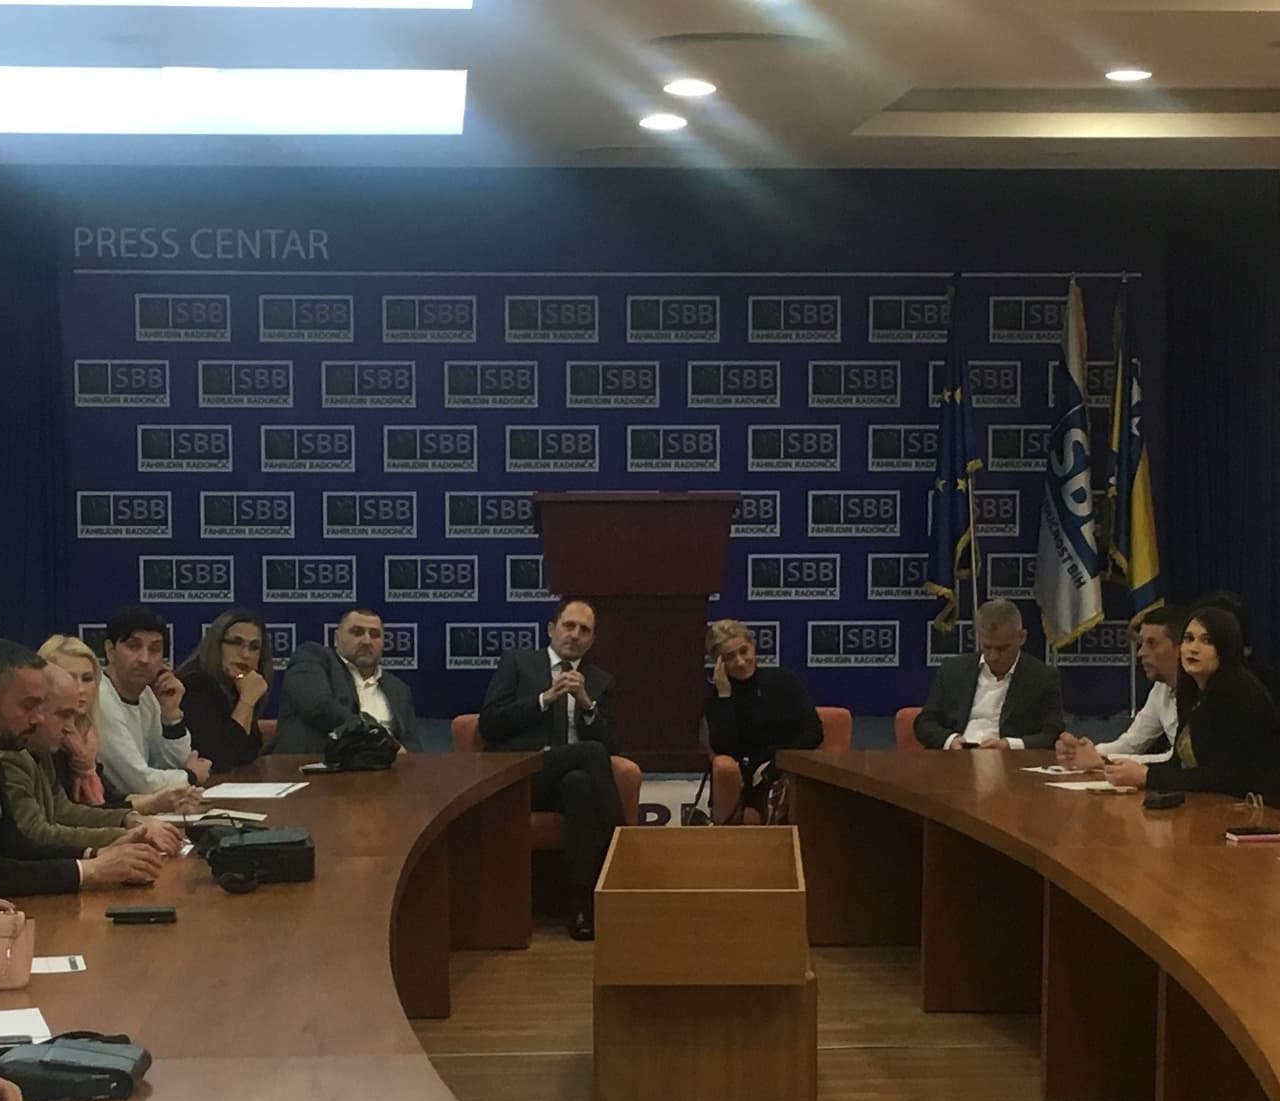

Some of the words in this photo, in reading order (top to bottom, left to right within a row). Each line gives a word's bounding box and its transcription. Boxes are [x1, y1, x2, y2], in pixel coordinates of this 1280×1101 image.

[73, 227, 179, 258] PRESS
[190, 228, 329, 259] CENTAR
[176, 303, 224, 323] SBB
[299, 304, 346, 324] SBB
[422, 304, 469, 325] SBB
[545, 304, 592, 325] SBB
[666, 305, 713, 325] SBB
[787, 305, 834, 325] SBB
[115, 369, 163, 389] SBB
[239, 369, 286, 389] SBB
[362, 370, 409, 390] SBB
[484, 370, 531, 390] SBB
[606, 370, 652, 390] SBB
[727, 370, 774, 390] SBB
[848, 370, 894, 390] SBB
[968, 370, 1014, 390] SBB
[1089, 370, 1115, 390] SB
[178, 434, 225, 454] SBB
[301, 434, 348, 454] SBB
[424, 434, 470, 454] SBB
[545, 434, 592, 454] SBB
[667, 434, 713, 454] SBB
[787, 434, 834, 454] SBB
[907, 434, 938, 454] SB
[117, 500, 165, 520] SBB
[240, 500, 288, 520] SBB
[363, 500, 410, 520] SBB
[485, 500, 531, 520] SBB
[847, 499, 893, 519] SBB
[180, 564, 227, 584] SBB
[302, 564, 349, 584] SBB
[424, 564, 471, 584] SBB
[787, 563, 833, 582] SBB
[382, 632, 411, 651] BB
[486, 632, 532, 651] SBB
[847, 629, 892, 649] SBB
